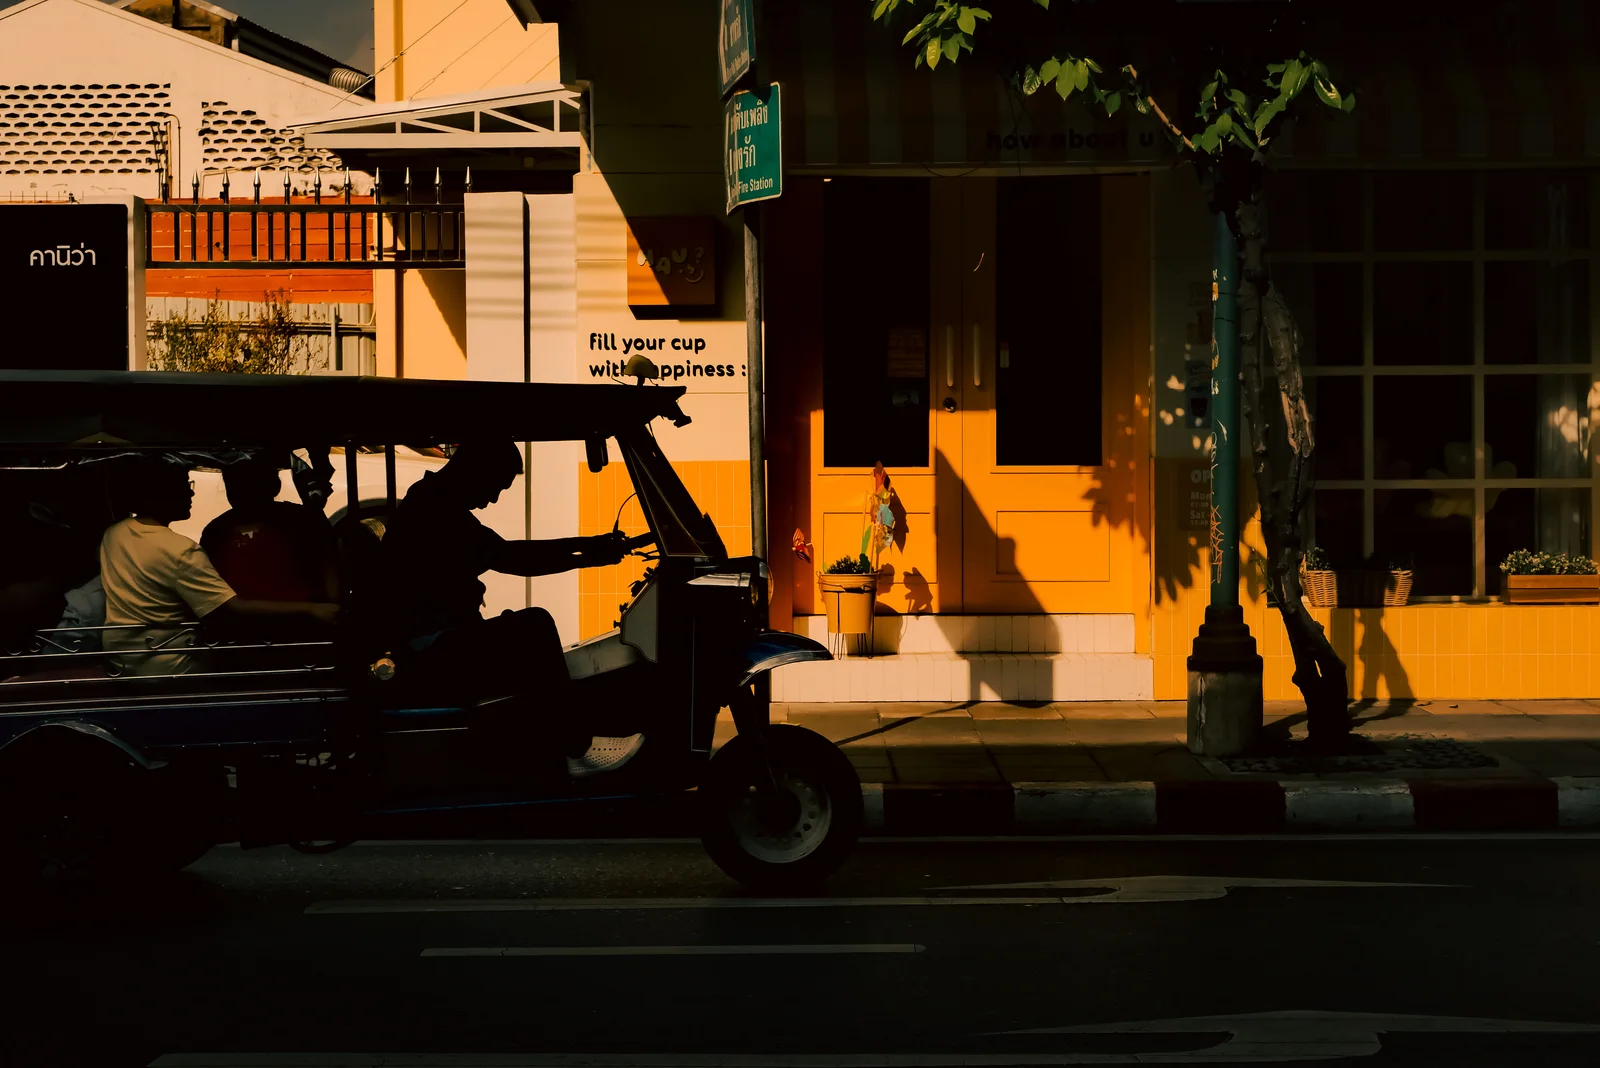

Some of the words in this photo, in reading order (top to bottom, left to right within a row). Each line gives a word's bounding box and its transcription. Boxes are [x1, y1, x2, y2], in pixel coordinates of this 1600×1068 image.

[986, 128, 1041, 150] how
[1139, 131, 1154, 147] u
[749, 176, 773, 192] Station
[589, 333, 617, 350] fill
[622, 337, 665, 354] your
[671, 337, 706, 354] cup
